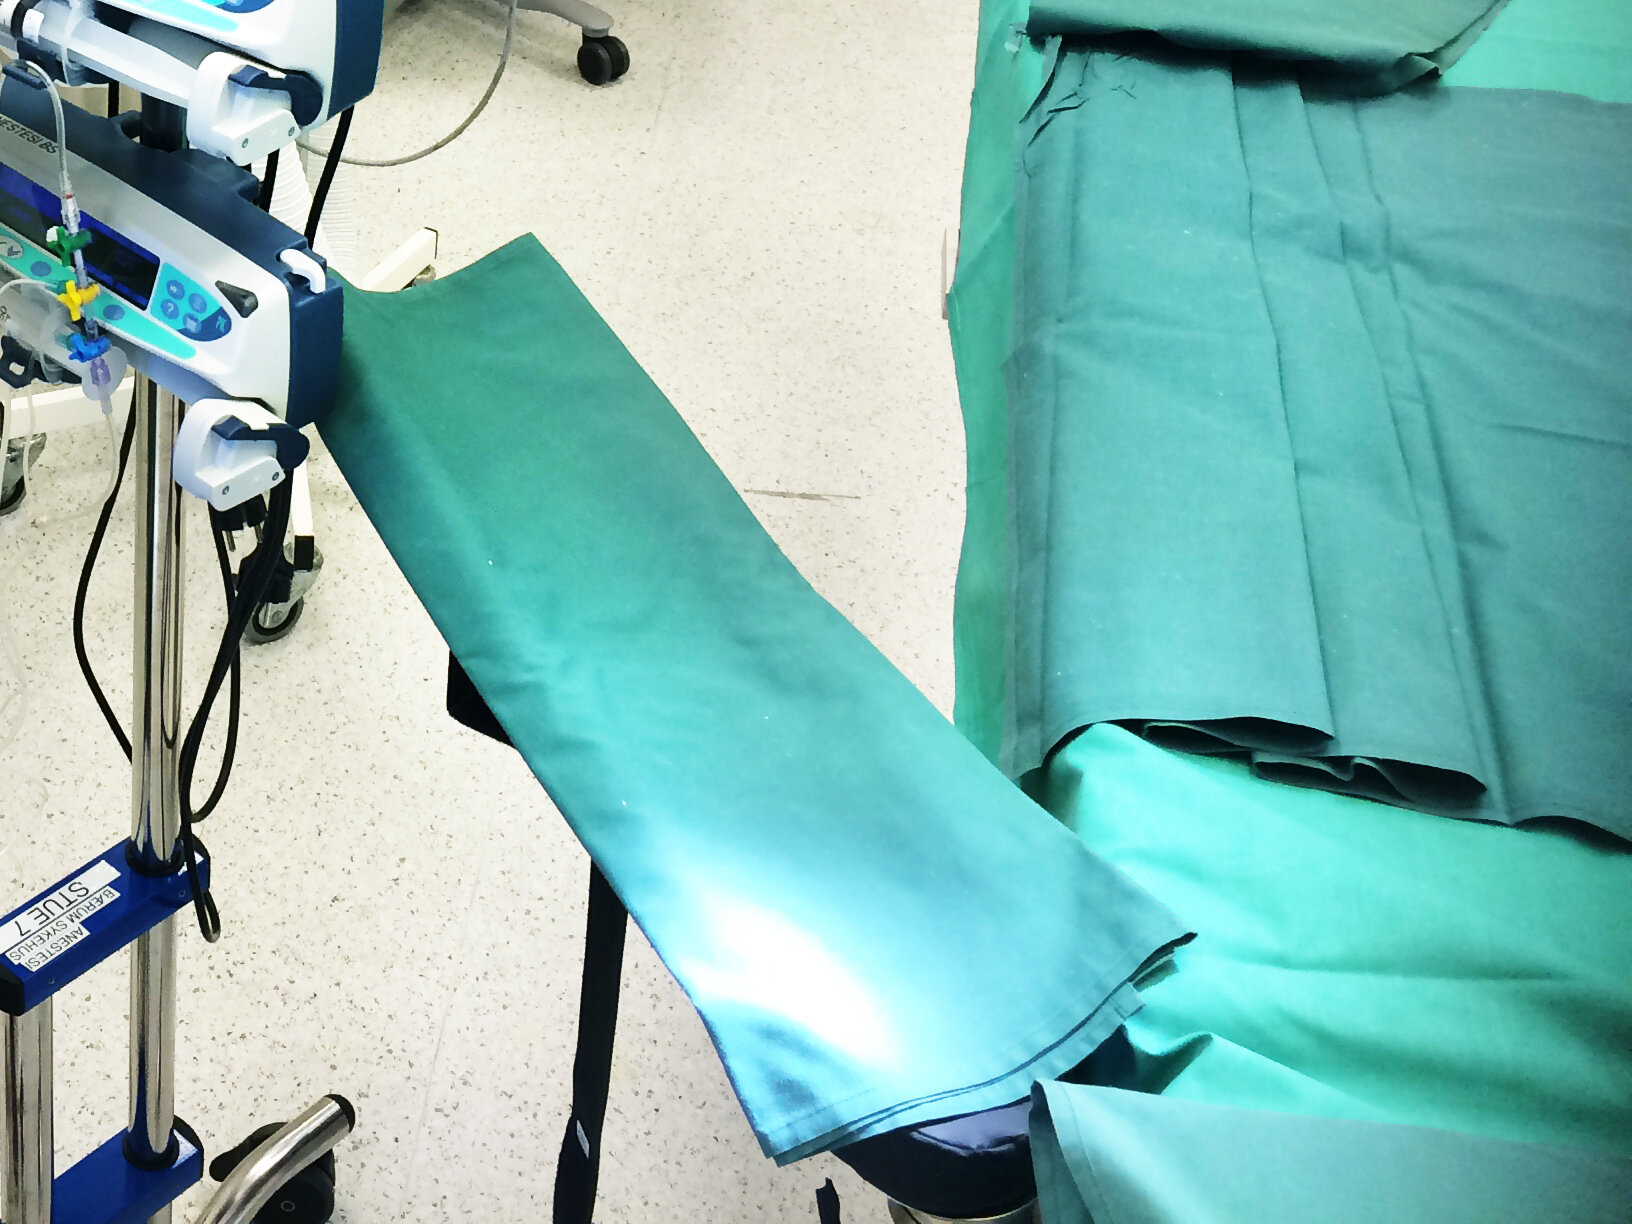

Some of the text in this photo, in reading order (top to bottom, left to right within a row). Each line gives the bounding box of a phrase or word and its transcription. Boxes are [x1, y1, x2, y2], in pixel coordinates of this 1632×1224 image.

[8, 888, 116, 962] BÆRUM SYKEHUS
[13, 881, 89, 938] STUE 7
[24, 925, 84, 971] ANESTESI
